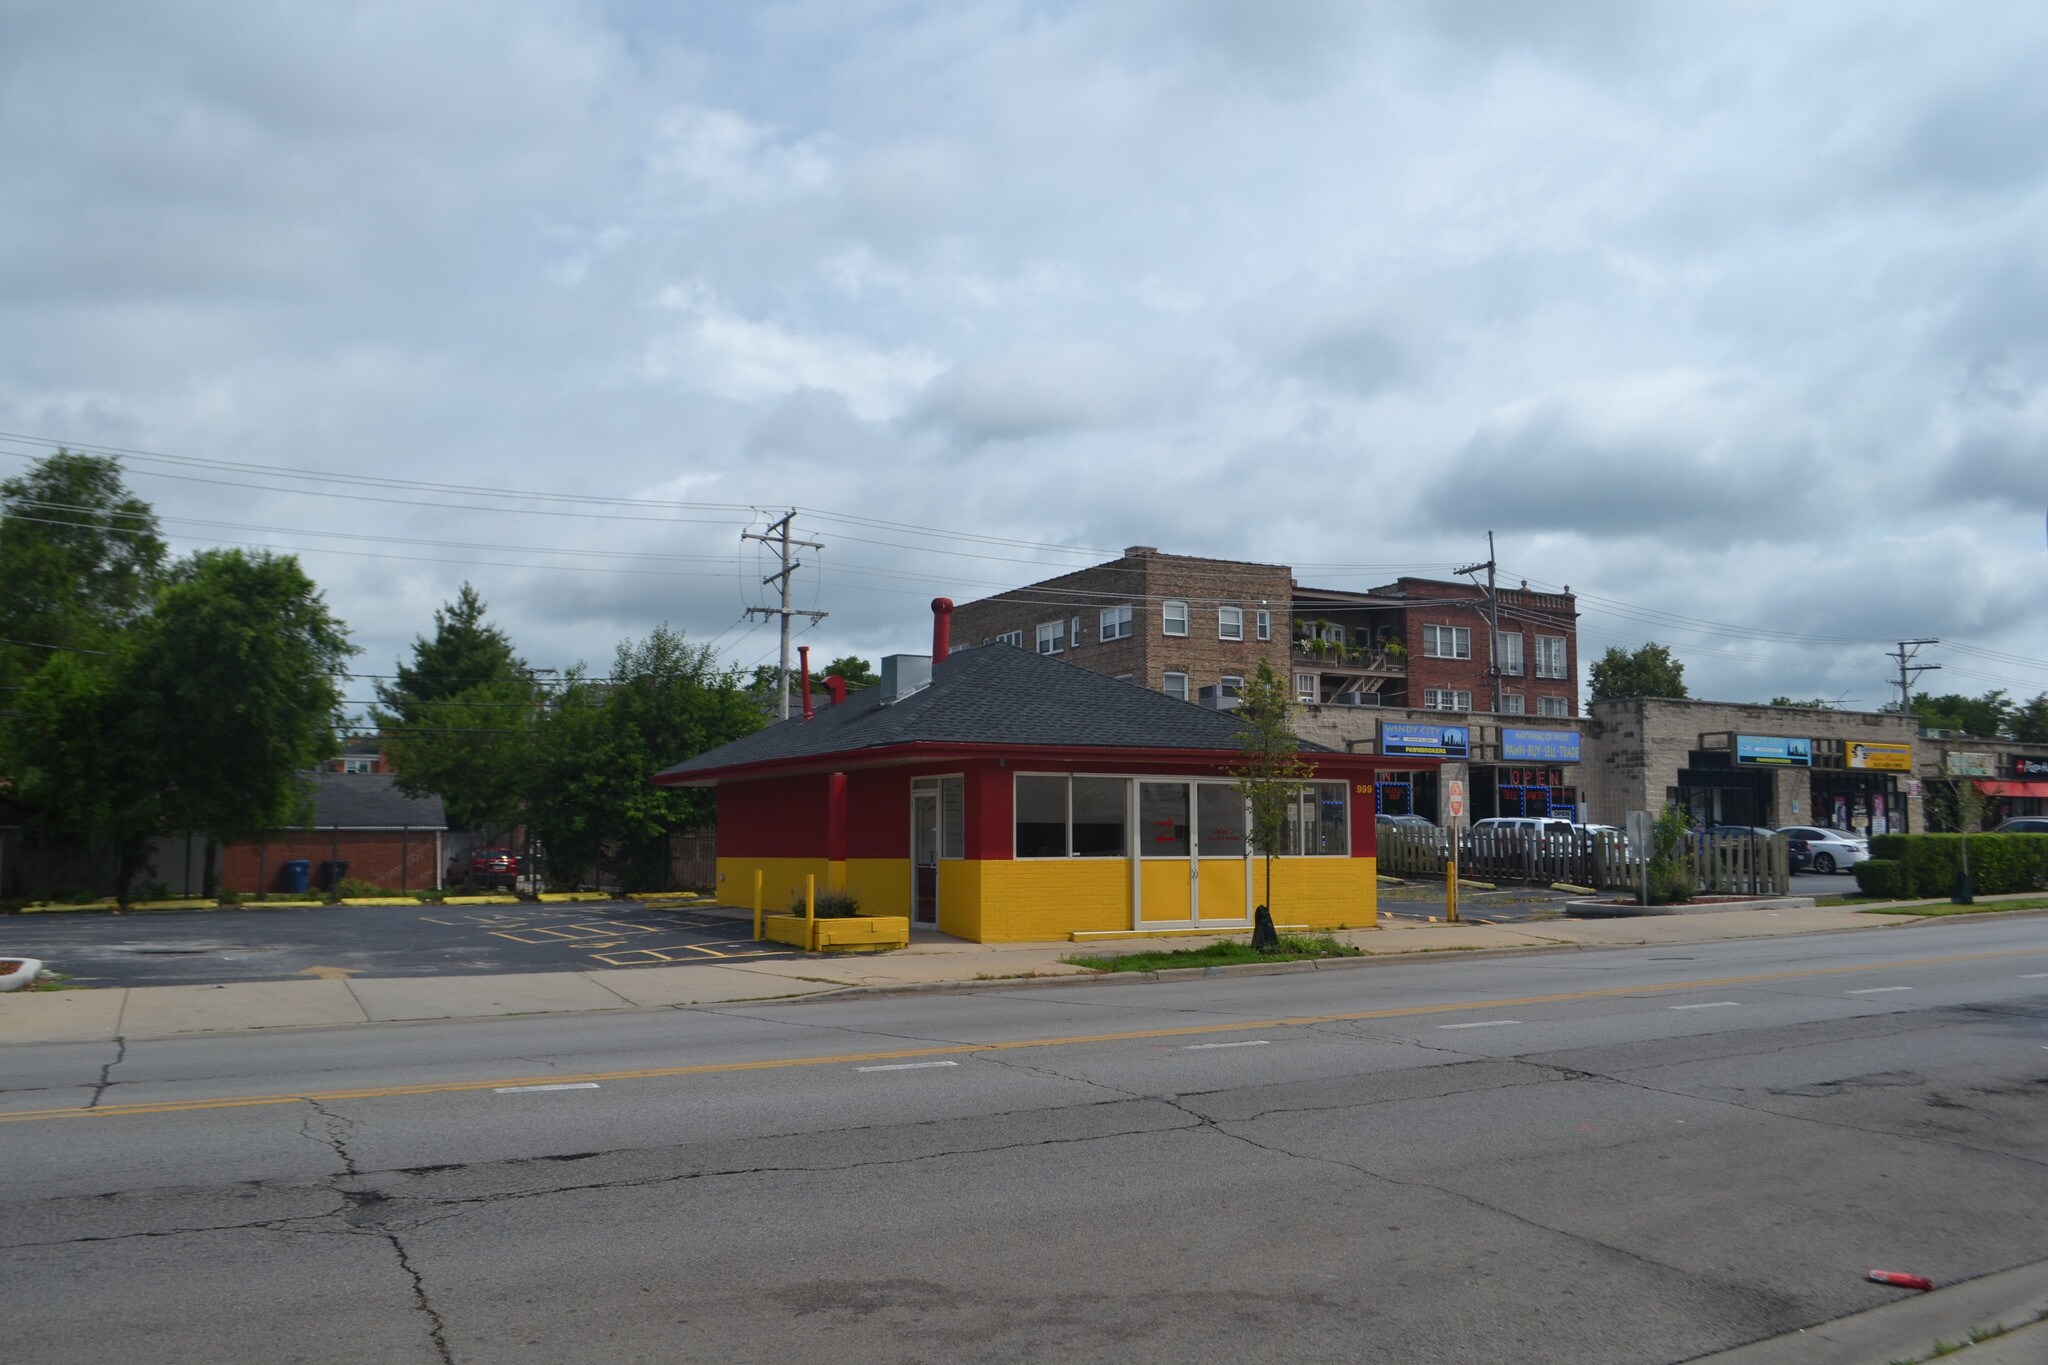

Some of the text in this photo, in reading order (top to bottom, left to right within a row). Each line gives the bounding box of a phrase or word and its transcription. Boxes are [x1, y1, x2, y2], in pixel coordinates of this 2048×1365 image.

[1385, 725, 1441, 735] WINDY CITY
[1515, 731, 1570, 742] ANYTHING OF VALUE
[1405, 746, 1447, 754] PAWNBROKERS
[1505, 744, 1580, 758] PAWN BUY SELL TRADE
[1511, 770, 1560, 786] OPEN
[1356, 784, 1373, 794] 999
